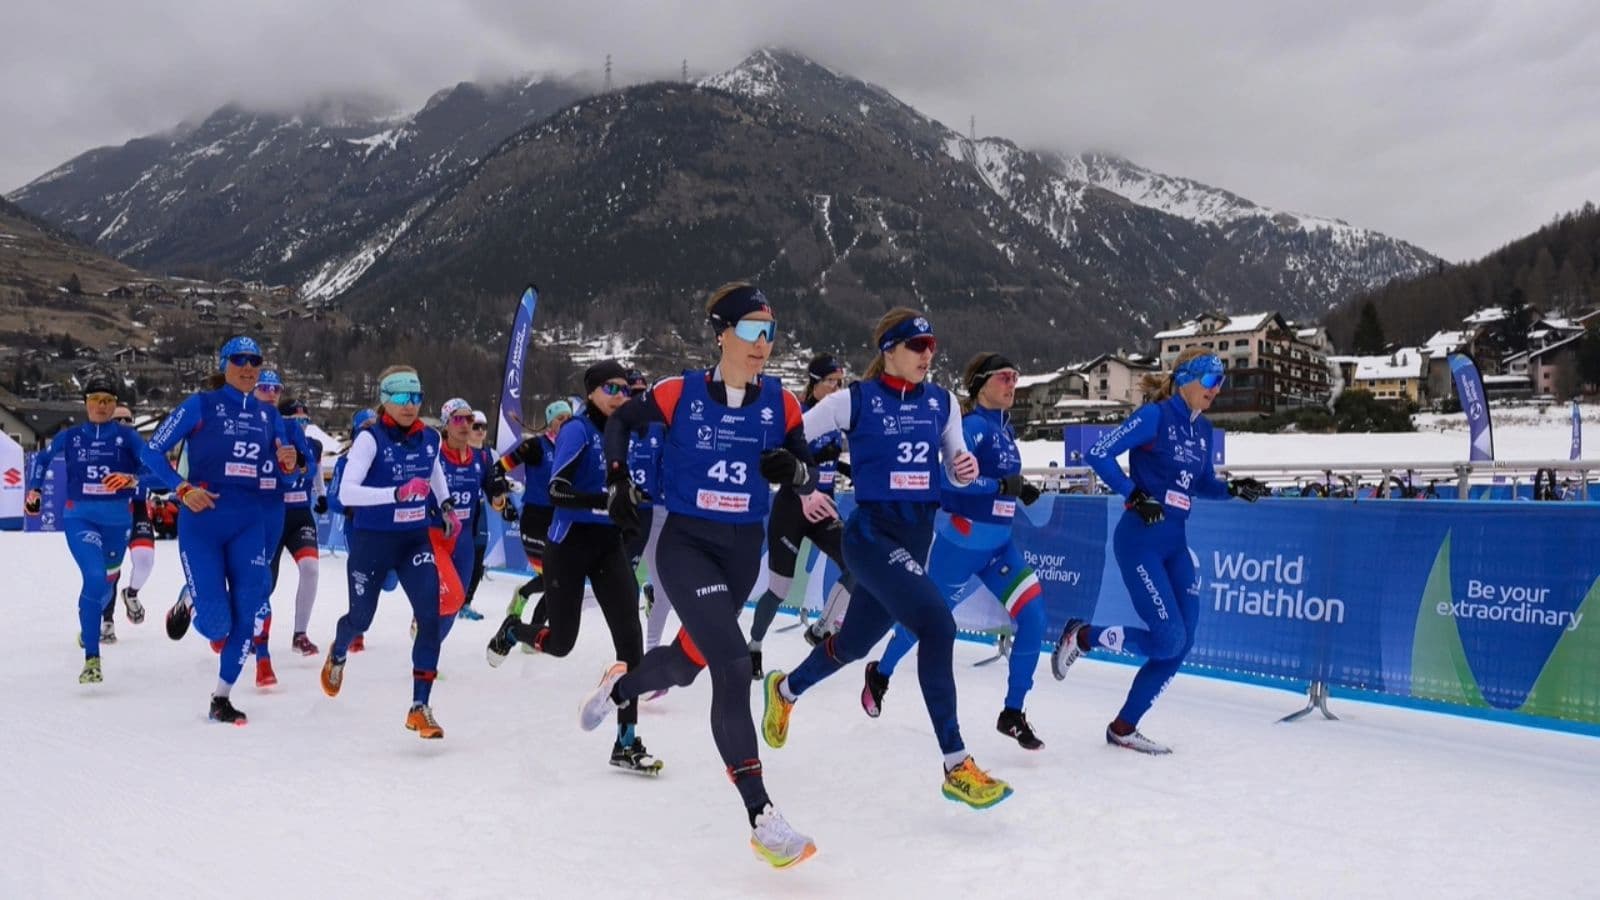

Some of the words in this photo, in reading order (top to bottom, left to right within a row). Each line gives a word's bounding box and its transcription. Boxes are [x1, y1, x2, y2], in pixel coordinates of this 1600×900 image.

[233, 441, 260, 460] 52
[897, 441, 930, 463] 32
[86, 465, 110, 479] 53
[707, 459, 747, 485] 43
[452, 491, 471, 504] 39
[1023, 550, 1038, 565] Be
[1039, 554, 1066, 569] your
[1213, 550, 1304, 585] World
[1136, 564, 1169, 620] SLOVAKIA
[1210, 582, 1345, 624] Triathlon
[1467, 579, 1496, 600] Be
[1498, 585, 1551, 604] your
[1435, 599, 1583, 631] extraordinary
